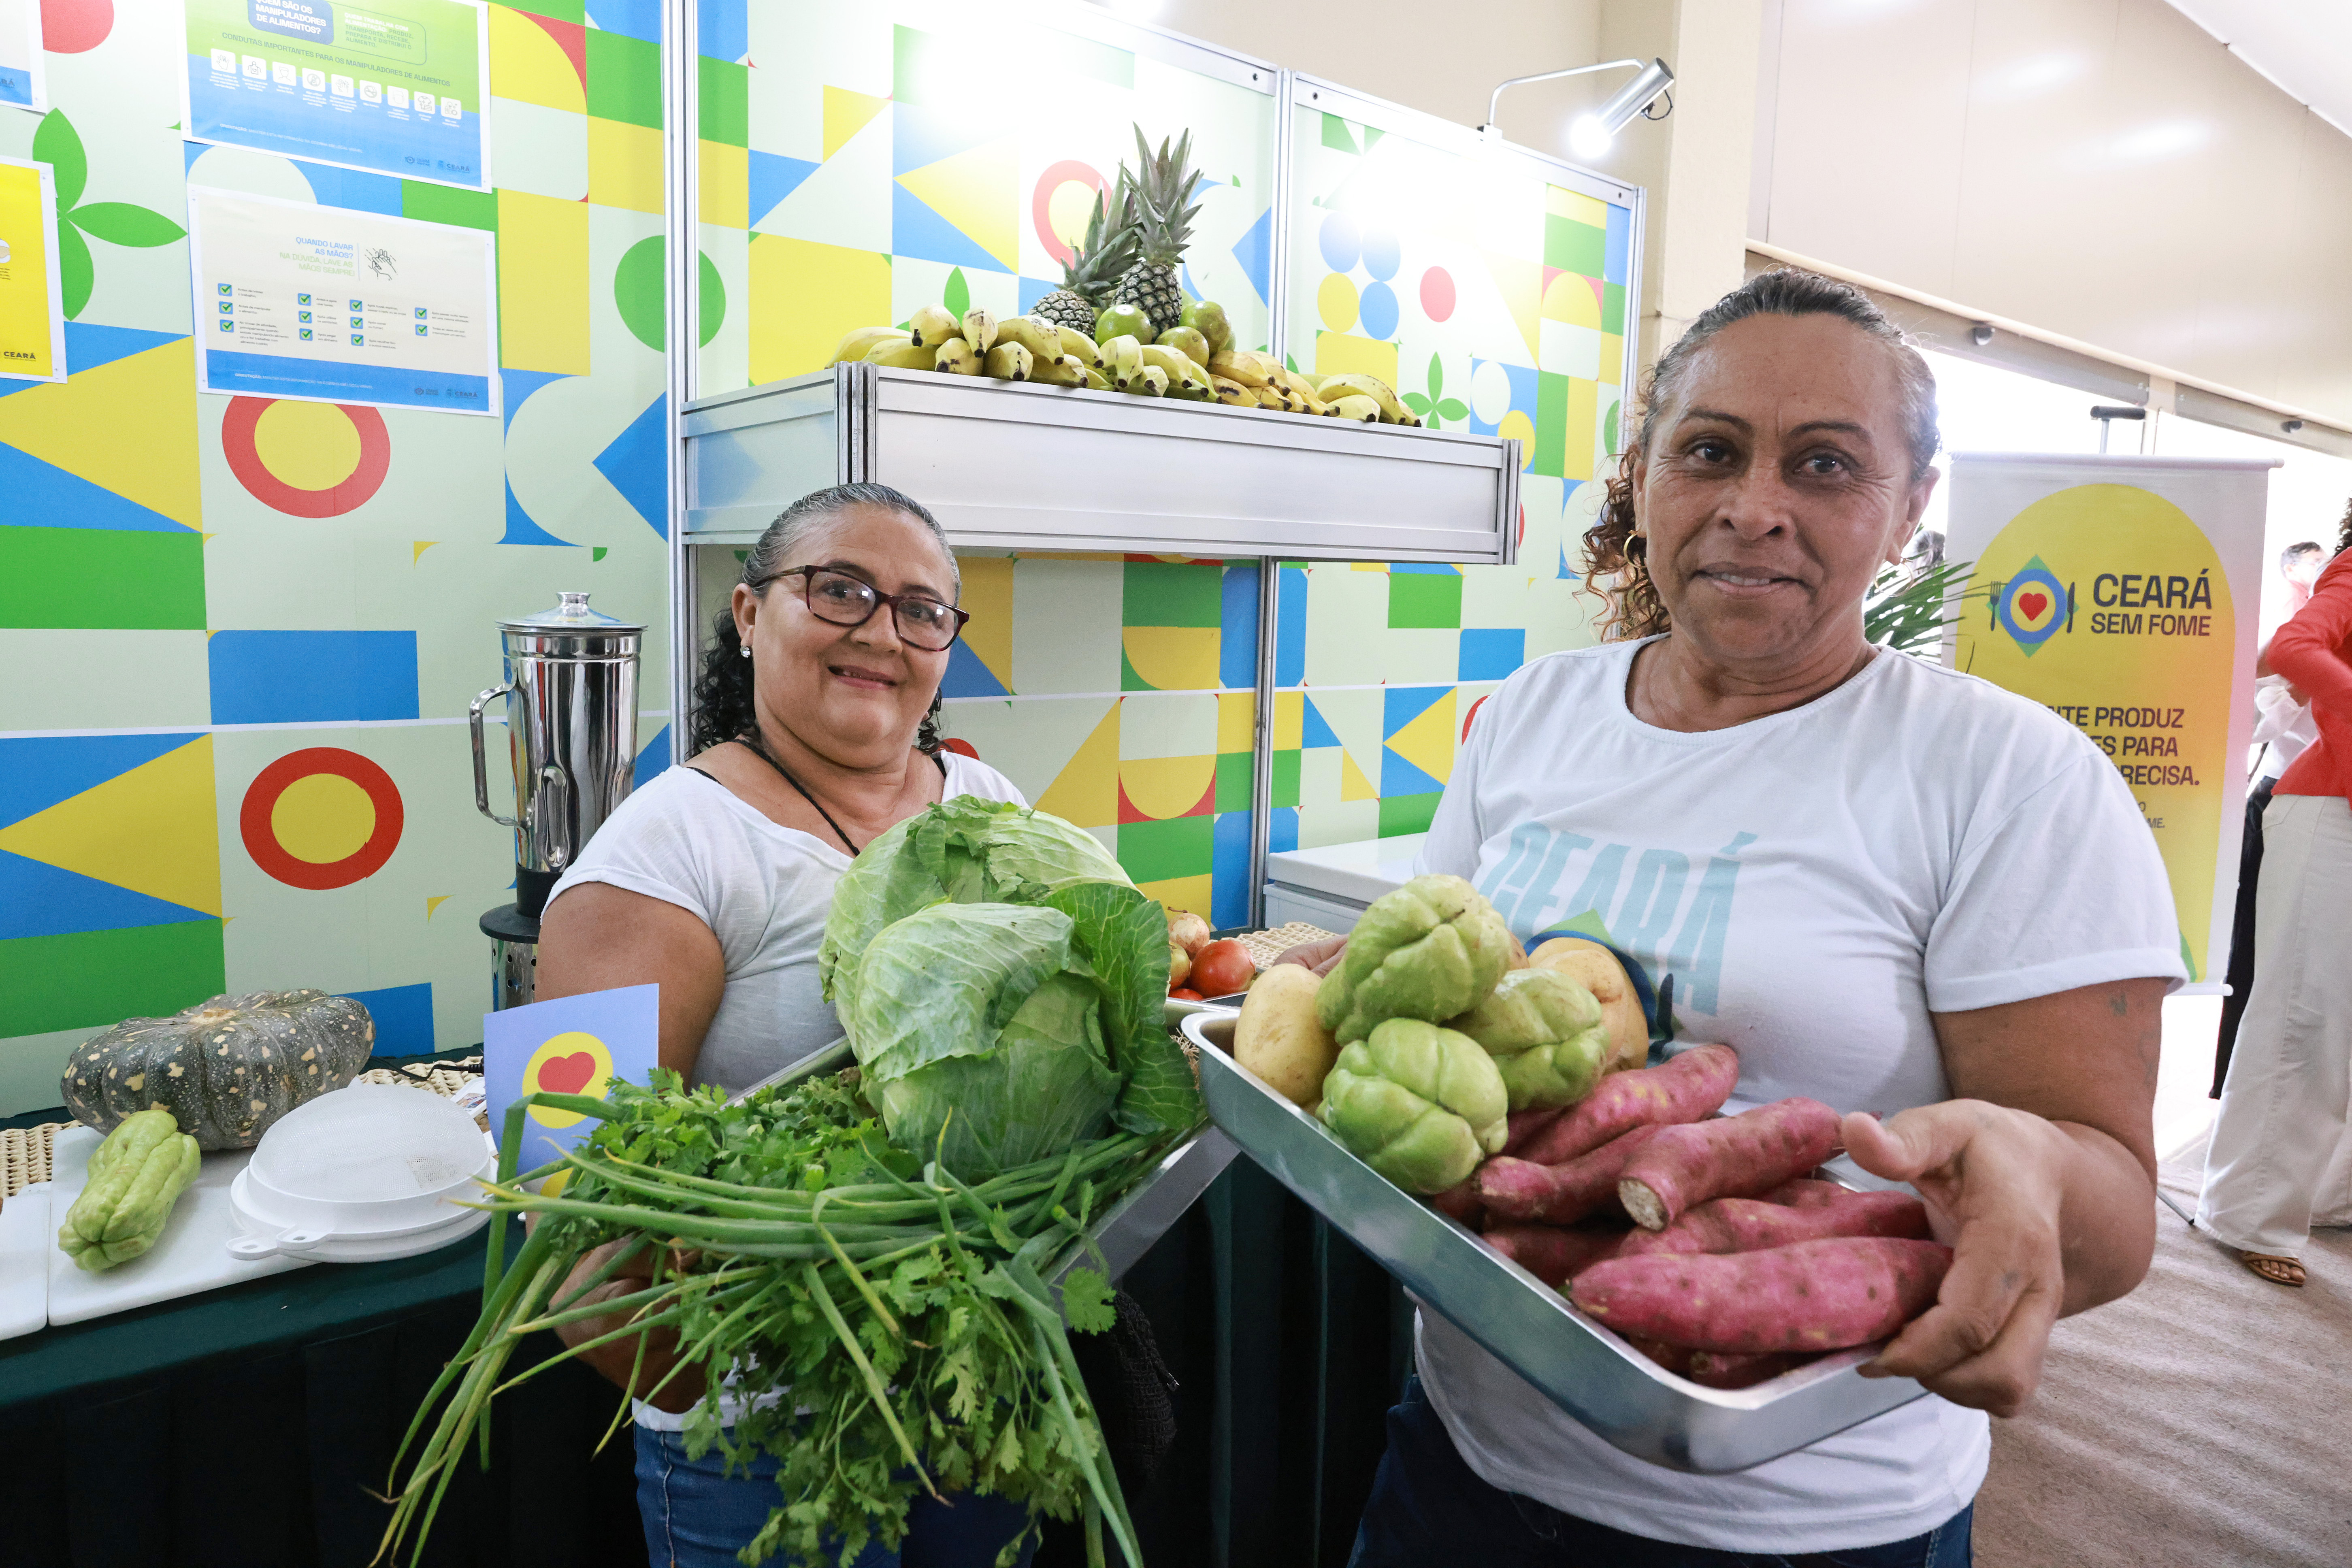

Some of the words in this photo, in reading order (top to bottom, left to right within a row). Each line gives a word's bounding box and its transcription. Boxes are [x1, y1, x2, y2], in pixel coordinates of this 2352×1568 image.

[256, 4, 326, 27] MANIPULADORES
[282, 1, 299, 11] SÃO
[301, 5, 313, 14] OS
[256, 14, 268, 22] DE
[269, 17, 321, 34] ALIMENTOS?
[345, 13, 362, 21] QUEM
[364, 17, 394, 28] TRABALHA
[346, 31, 372, 40] PREPARA
[379, 38, 406, 49] DISTRIBUI
[222, 32, 262, 46] CONDUTAS
[264, 41, 314, 57] IMPORTANTES
[316, 53, 333, 62] PARA
[346, 59, 403, 76] MANIPULADORES
[414, 75, 450, 86] ALIMENTOS
[296, 237, 328, 247] QUANDO
[330, 242, 353, 250] LAVAR
[292, 253, 322, 264] DÚVIDA,
[324, 258, 341, 266] LAVE
[327, 249, 353, 259] MÃOS?
[299, 264, 321, 272] MÃOS
[4, 352, 36, 360] CEARÁ
[2093, 568, 2212, 609] CEARÁ
[2091, 612, 2142, 635] SEM
[2148, 614, 2211, 636] FOME
[2094, 707, 2184, 728] PRODUZ
[2122, 736, 2178, 756] PARA
[2116, 765, 2199, 786] RECISA.
[1477, 821, 1758, 1016] CEARÁ
